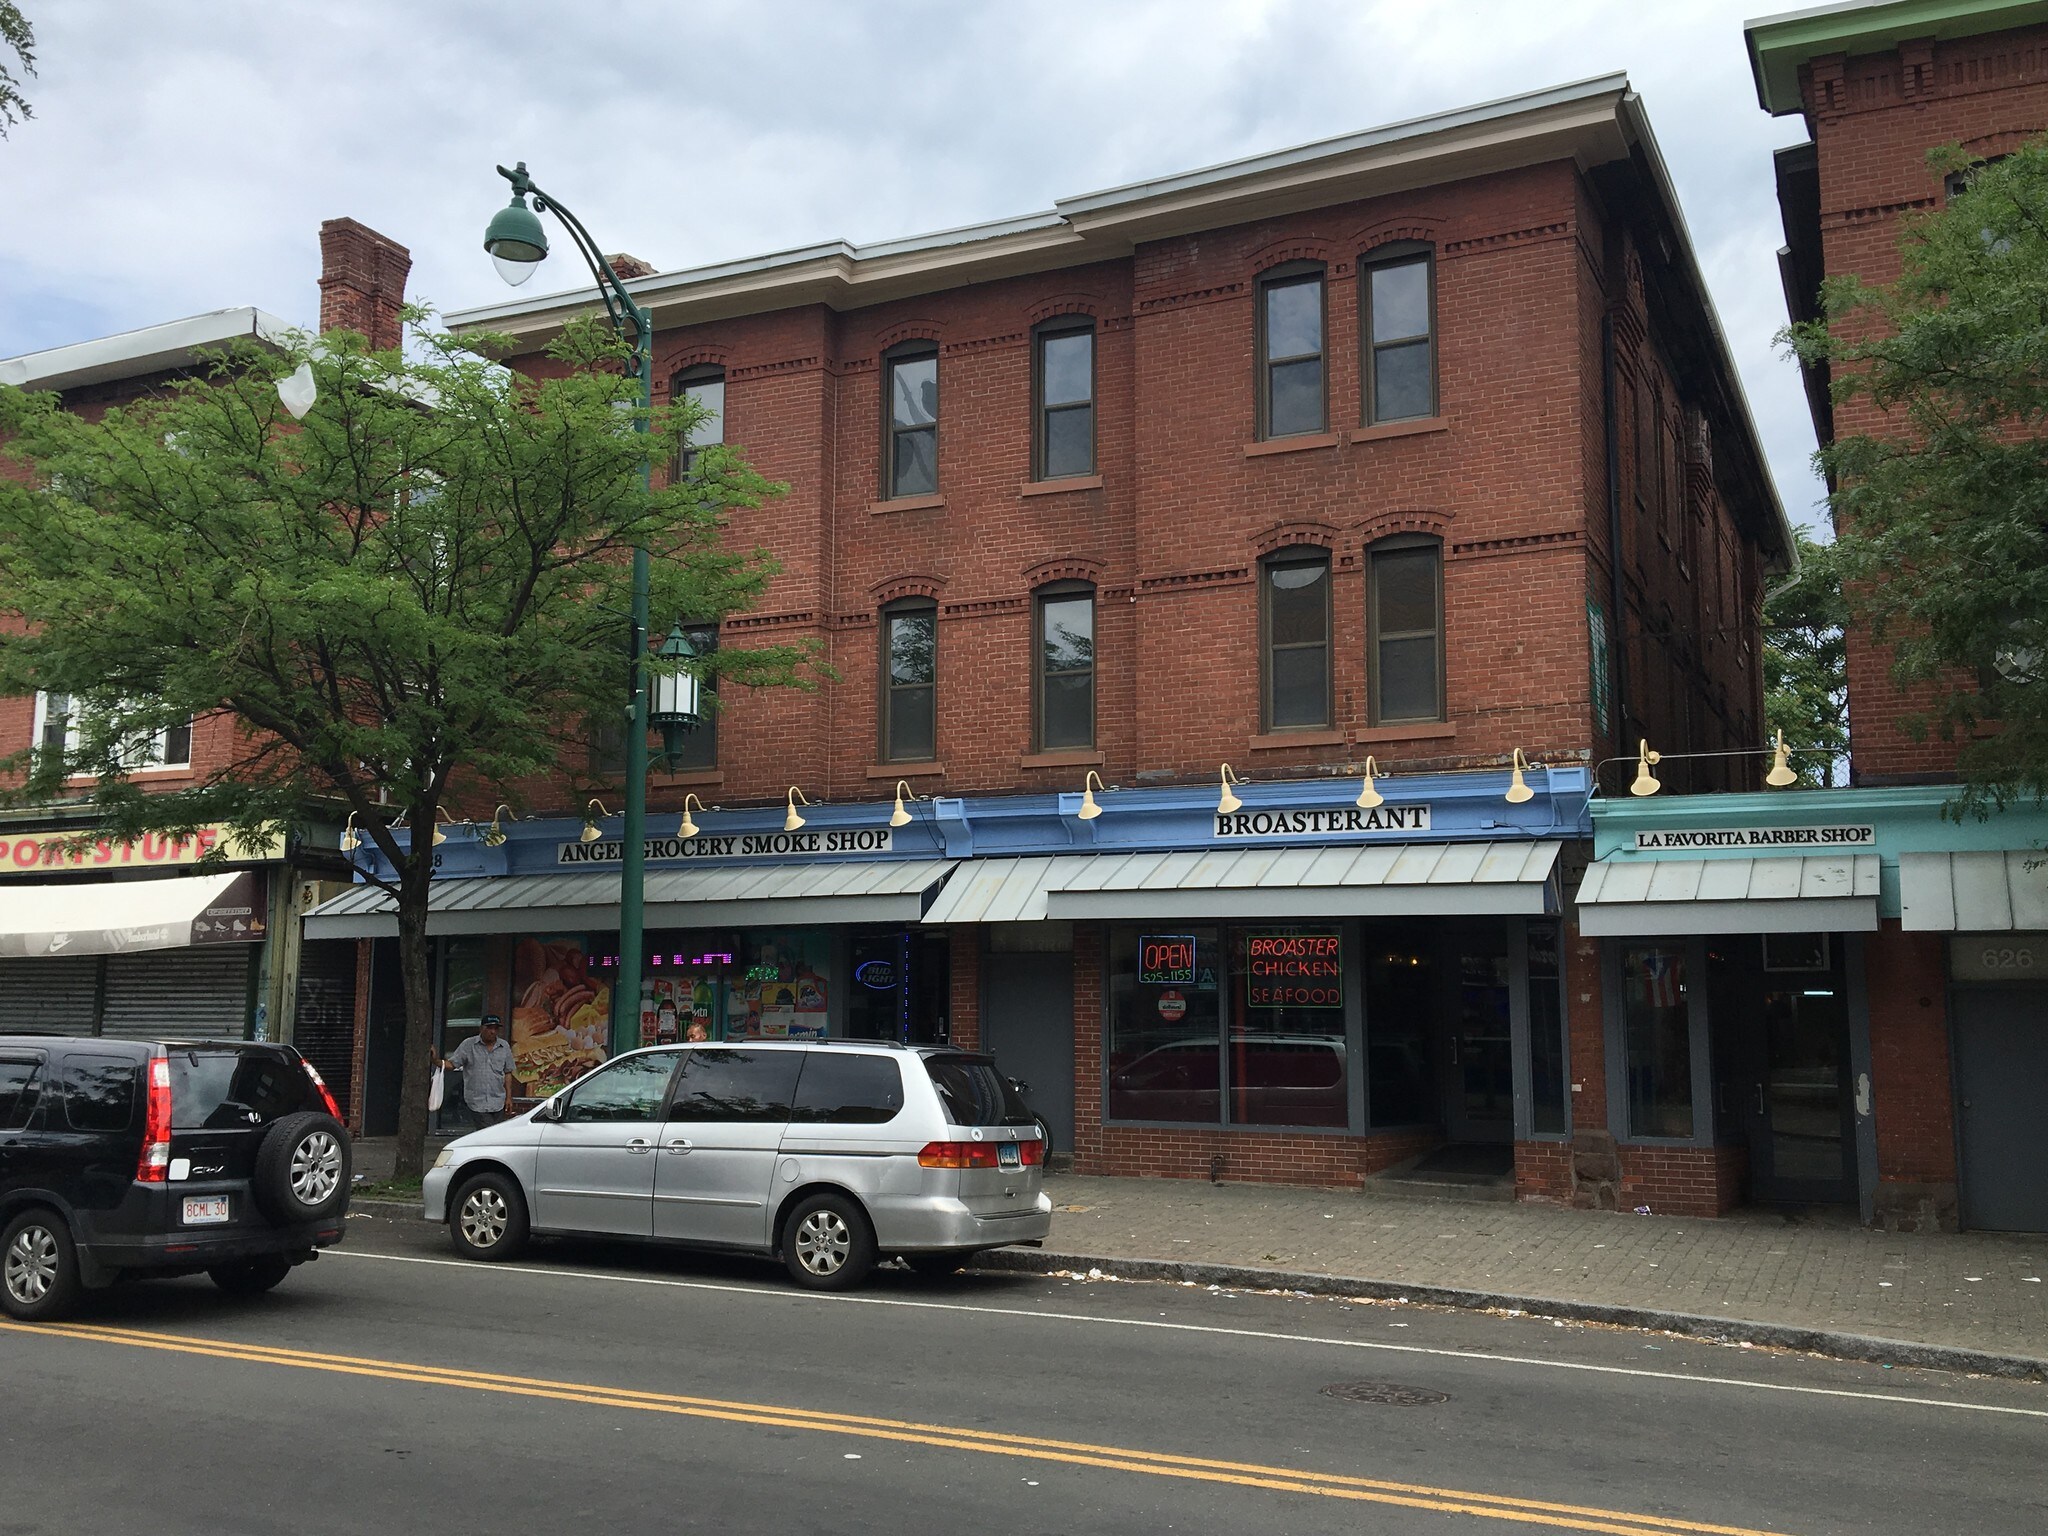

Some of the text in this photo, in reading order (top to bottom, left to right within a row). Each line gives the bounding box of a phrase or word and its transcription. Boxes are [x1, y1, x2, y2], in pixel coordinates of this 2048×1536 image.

[1217, 807, 1427, 836] BROASTERANT
[741, 833, 821, 855] SMOKE
[826, 830, 889, 851] SHOP
[1638, 827, 1873, 847] LA FAVORITA BARBER SHOP
[1250, 938, 1339, 956] BROASTER
[1145, 944, 1192, 970] OPEN
[1982, 948, 2034, 968] 626
[868, 967, 892, 976] BUD
[1143, 969, 1193, 983] 525-1155
[1252, 961, 1338, 977] CHICKEN
[863, 975, 895, 983] LIGHT
[1251, 988, 1340, 1004] SEAFOOD
[186, 1202, 227, 1217] 8CML 30
